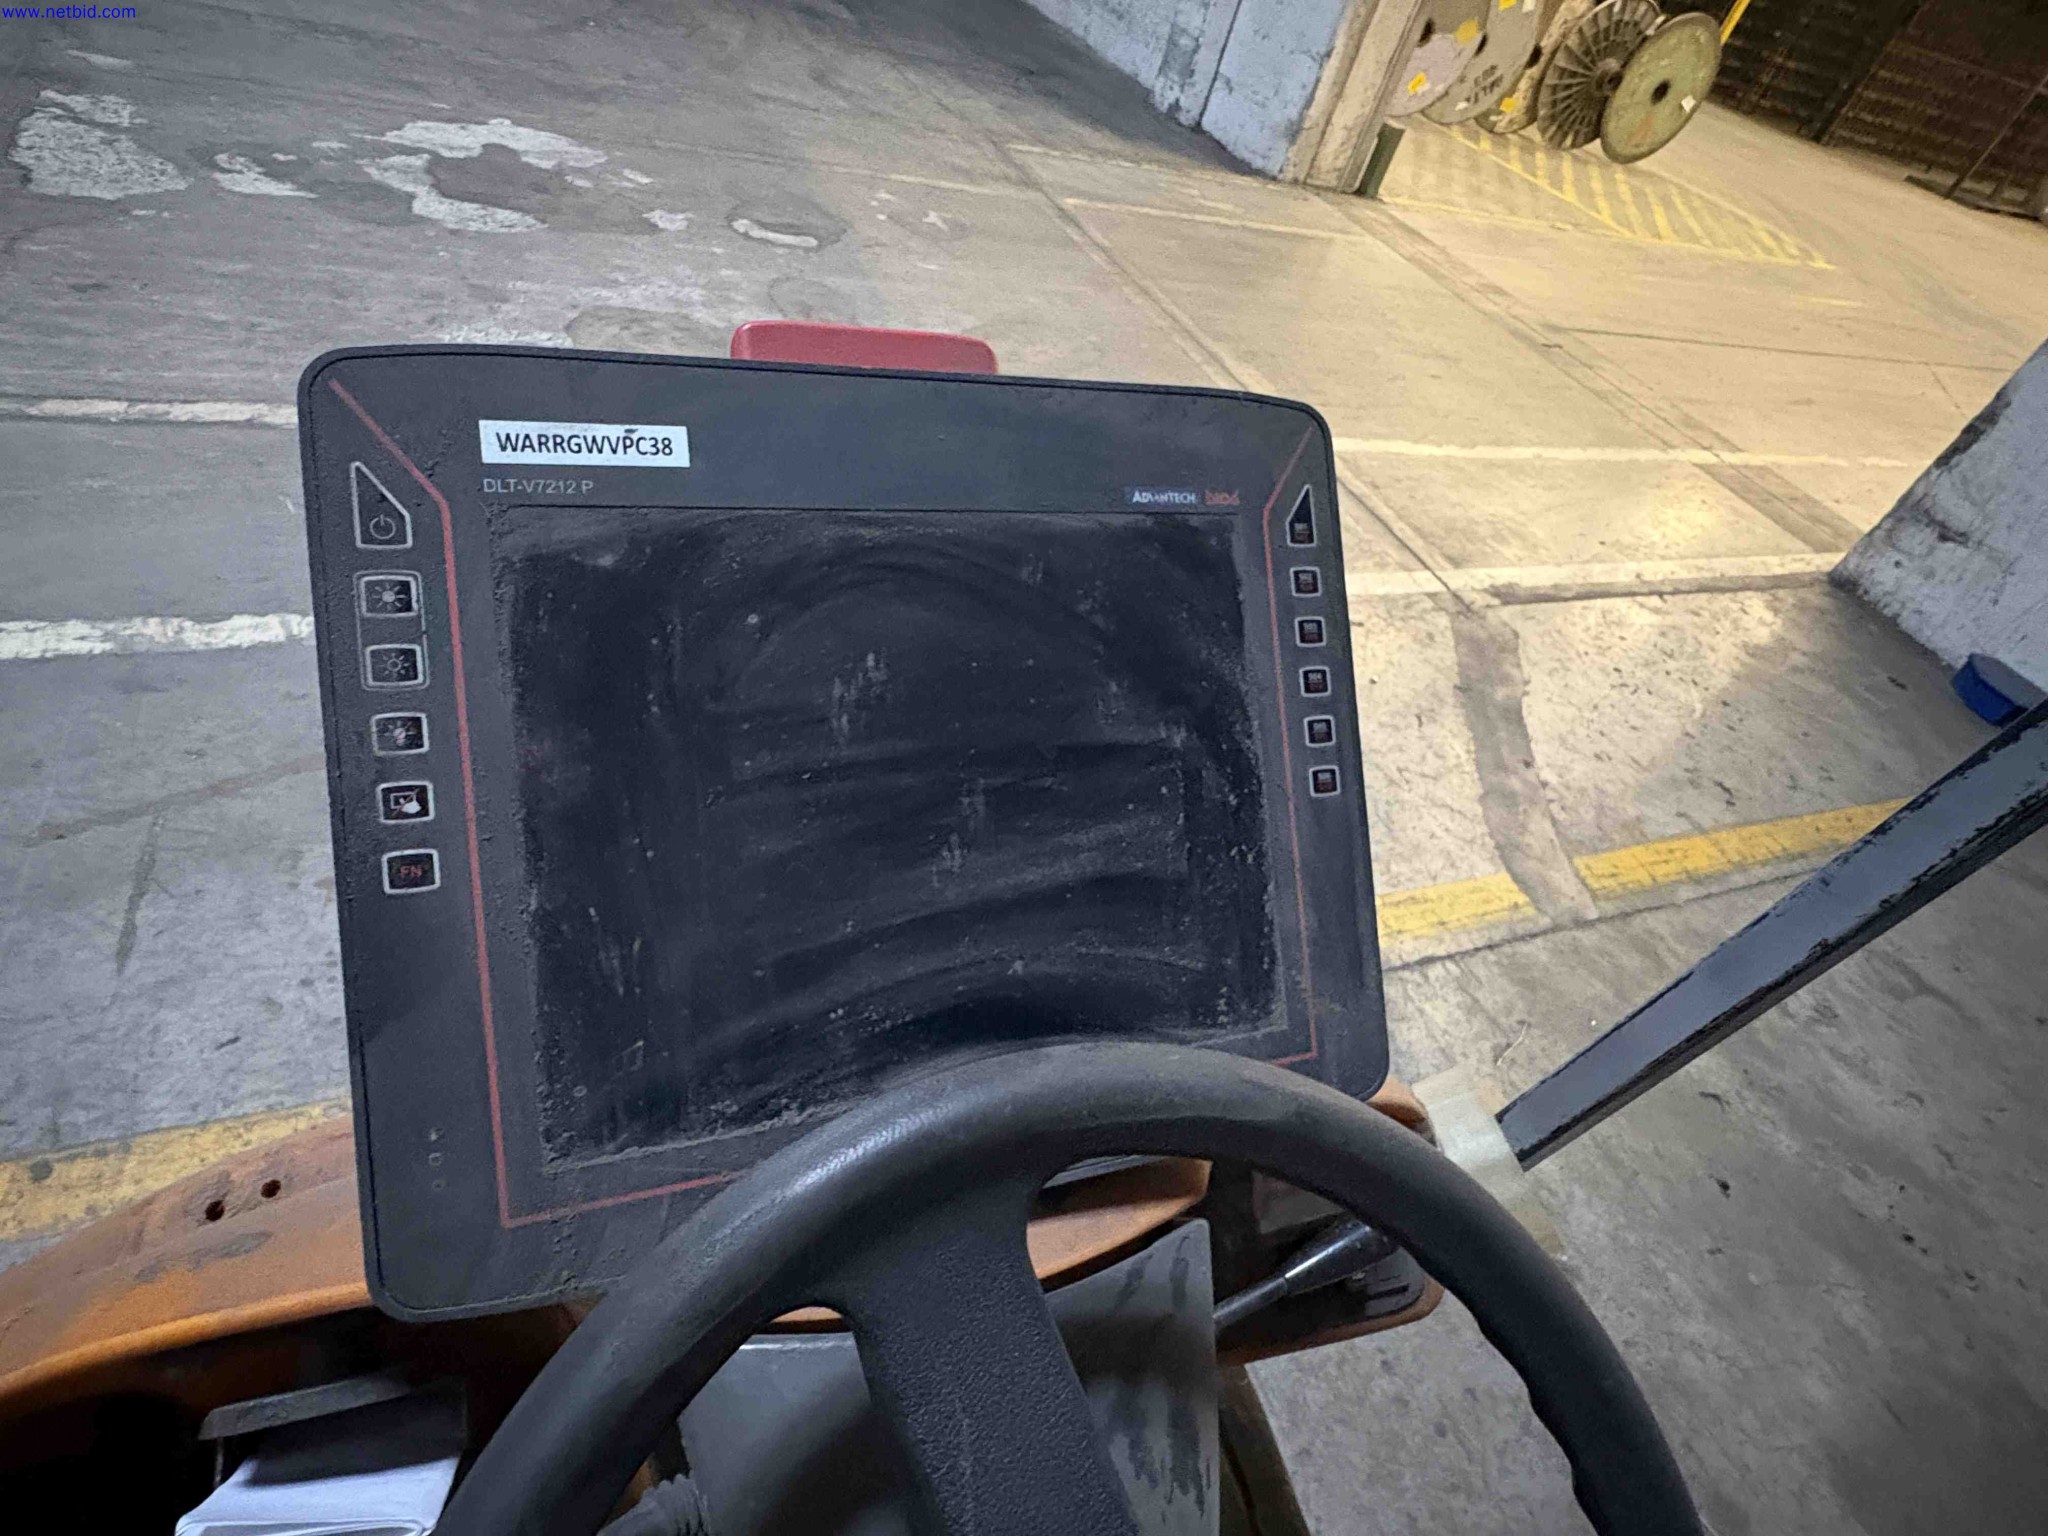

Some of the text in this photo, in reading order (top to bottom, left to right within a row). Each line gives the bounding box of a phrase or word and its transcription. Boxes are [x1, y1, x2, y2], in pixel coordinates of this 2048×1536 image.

[496, 432, 673, 456] WARRGWVPC38
[483, 478, 594, 494] DLT-V7212 P
